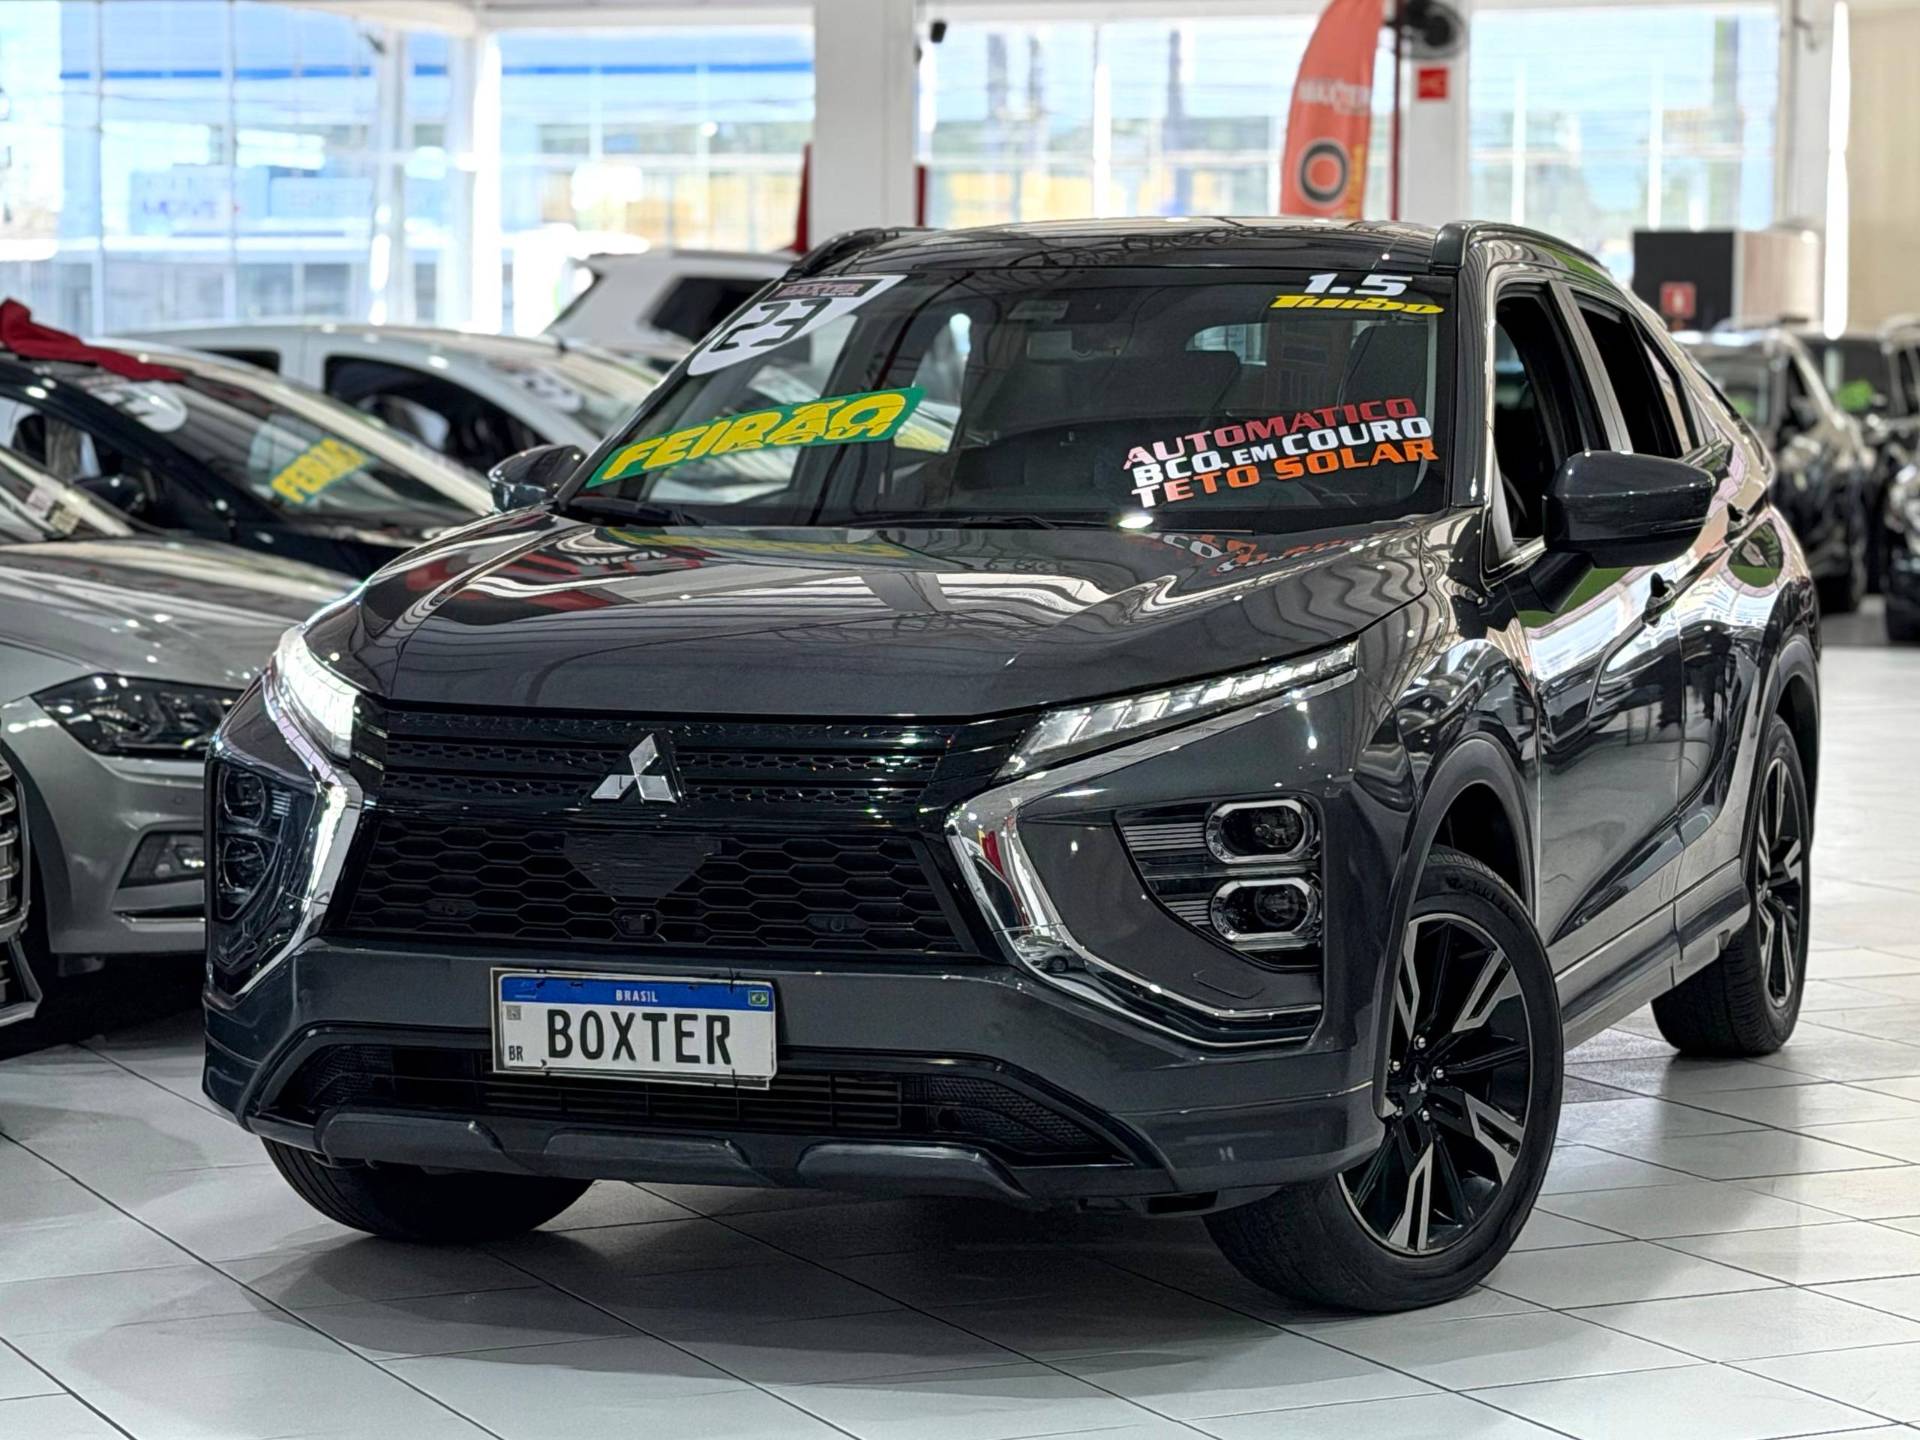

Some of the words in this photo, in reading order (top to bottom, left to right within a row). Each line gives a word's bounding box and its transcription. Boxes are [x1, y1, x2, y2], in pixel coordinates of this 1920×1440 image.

[1270, 295, 1444, 314] Turbo
[1304, 273, 1413, 297] 1.5
[709, 298, 832, 353] 23
[602, 394, 907, 481] FEIRÃO
[1123, 398, 1419, 470] AUTOMATICO
[1232, 442, 1278, 467] EM
[1283, 416, 1433, 456] COURO
[1131, 465, 1260, 509] TETO
[1274, 437, 1439, 481] SOLAR
[616, 989, 658, 1003] BRASIL
[508, 1045, 524, 1063] BR
[547, 1009, 732, 1066] BOXTER
